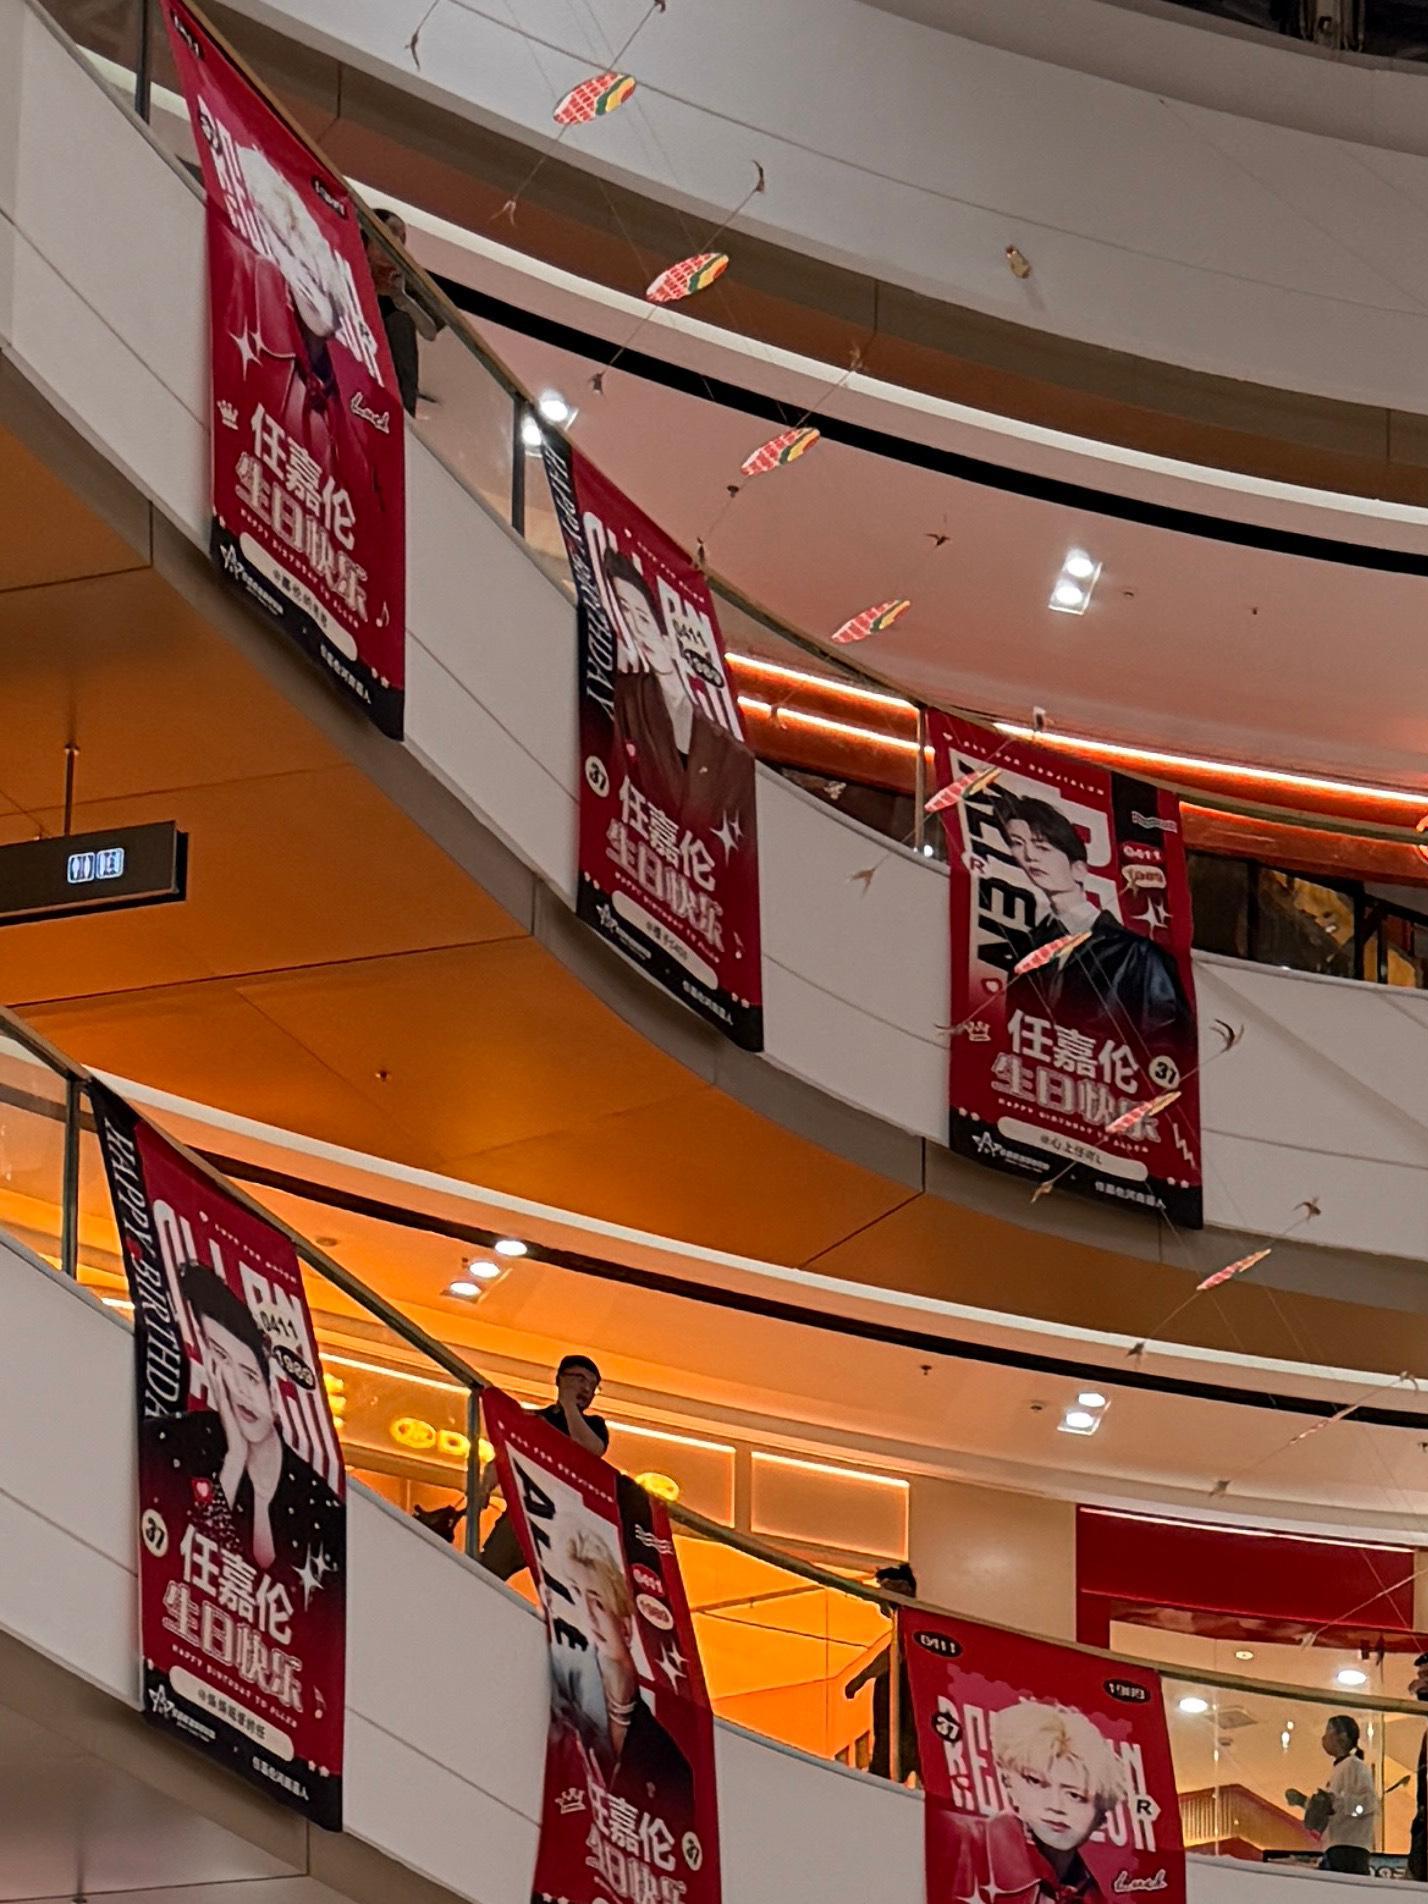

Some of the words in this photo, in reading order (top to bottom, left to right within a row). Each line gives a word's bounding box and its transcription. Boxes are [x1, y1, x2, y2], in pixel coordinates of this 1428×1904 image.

[234, 451, 368, 622] 生日快乐
[250, 403, 355, 547] 任嘉伦
[606, 823, 723, 947] 生日快乐
[619, 776, 715, 891] 任嘉伦
[1008, 1009, 1140, 1094] 任嘉伦
[180, 1523, 293, 1645] 任嘉伦
[163, 1581, 304, 1711] 生日快乐
[589, 1781, 675, 1867] 任嘉伦
